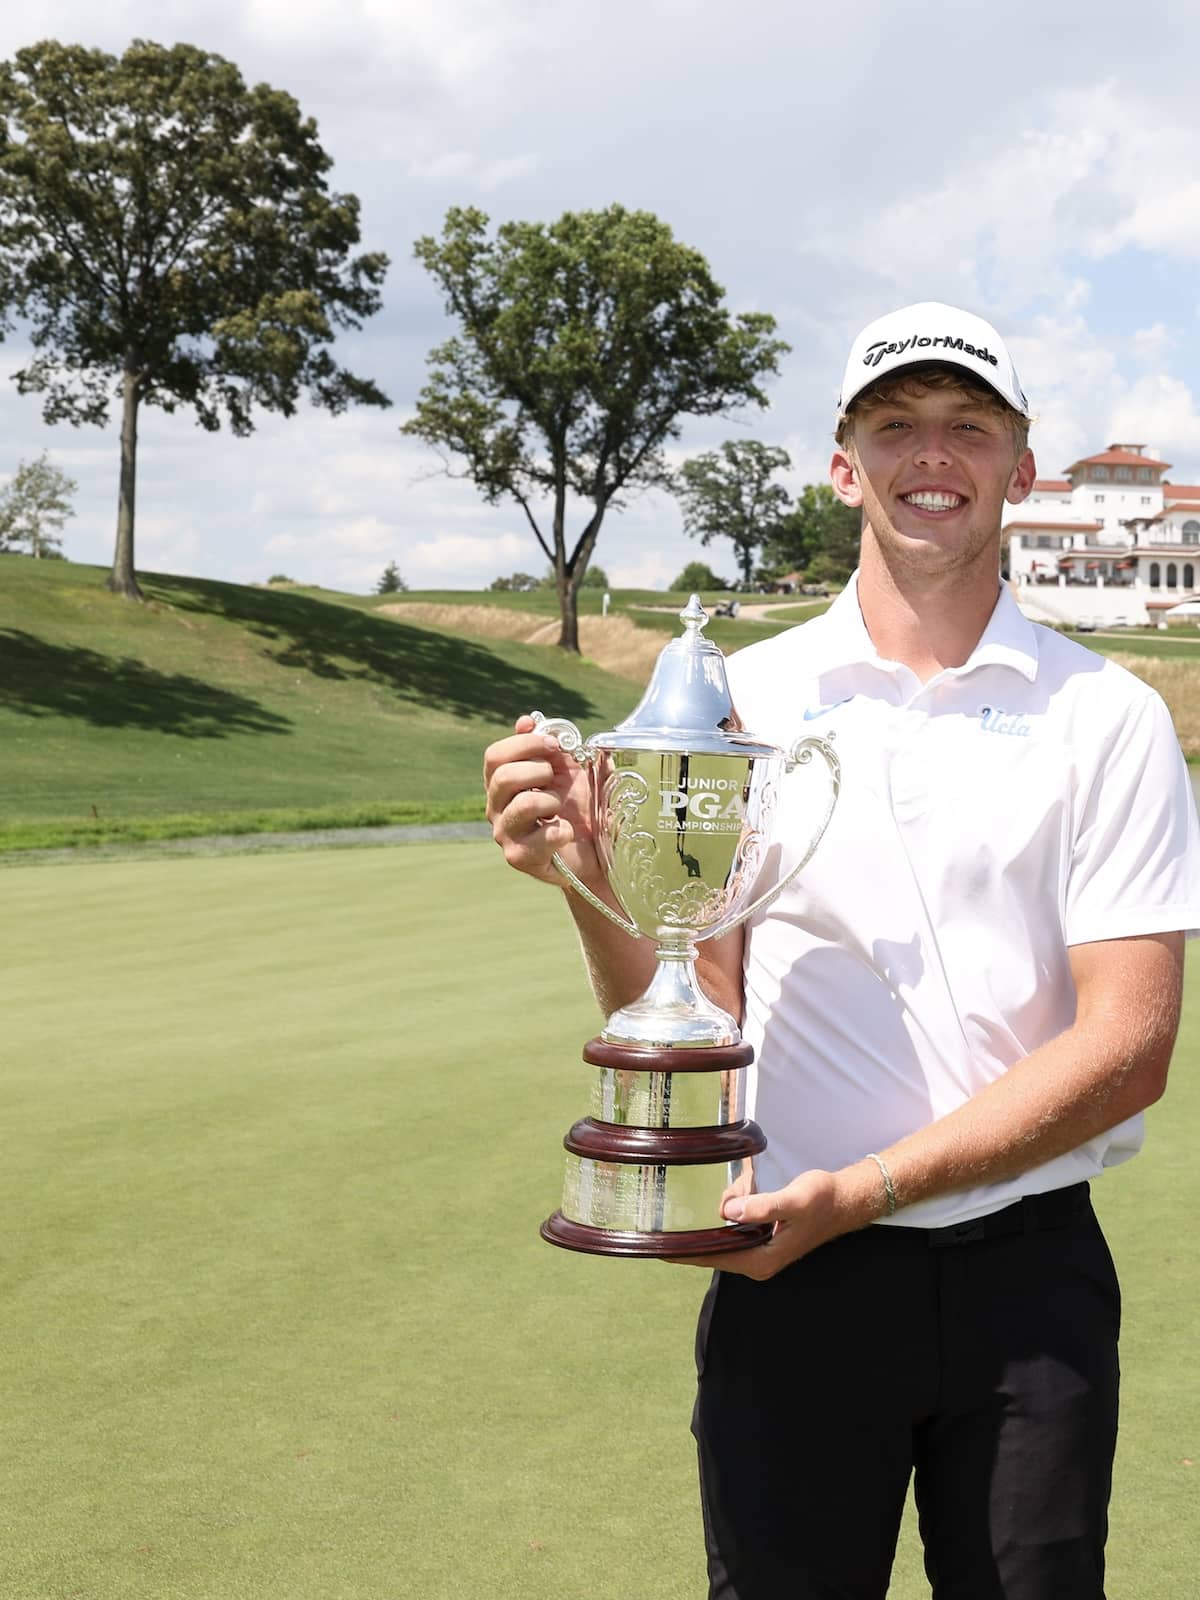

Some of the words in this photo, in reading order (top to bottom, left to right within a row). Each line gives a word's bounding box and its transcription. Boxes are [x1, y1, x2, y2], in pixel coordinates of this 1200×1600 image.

[863, 335, 998, 367] TaylorMade
[678, 777, 738, 791] JUNIOR
[658, 790, 745, 819] PGA
